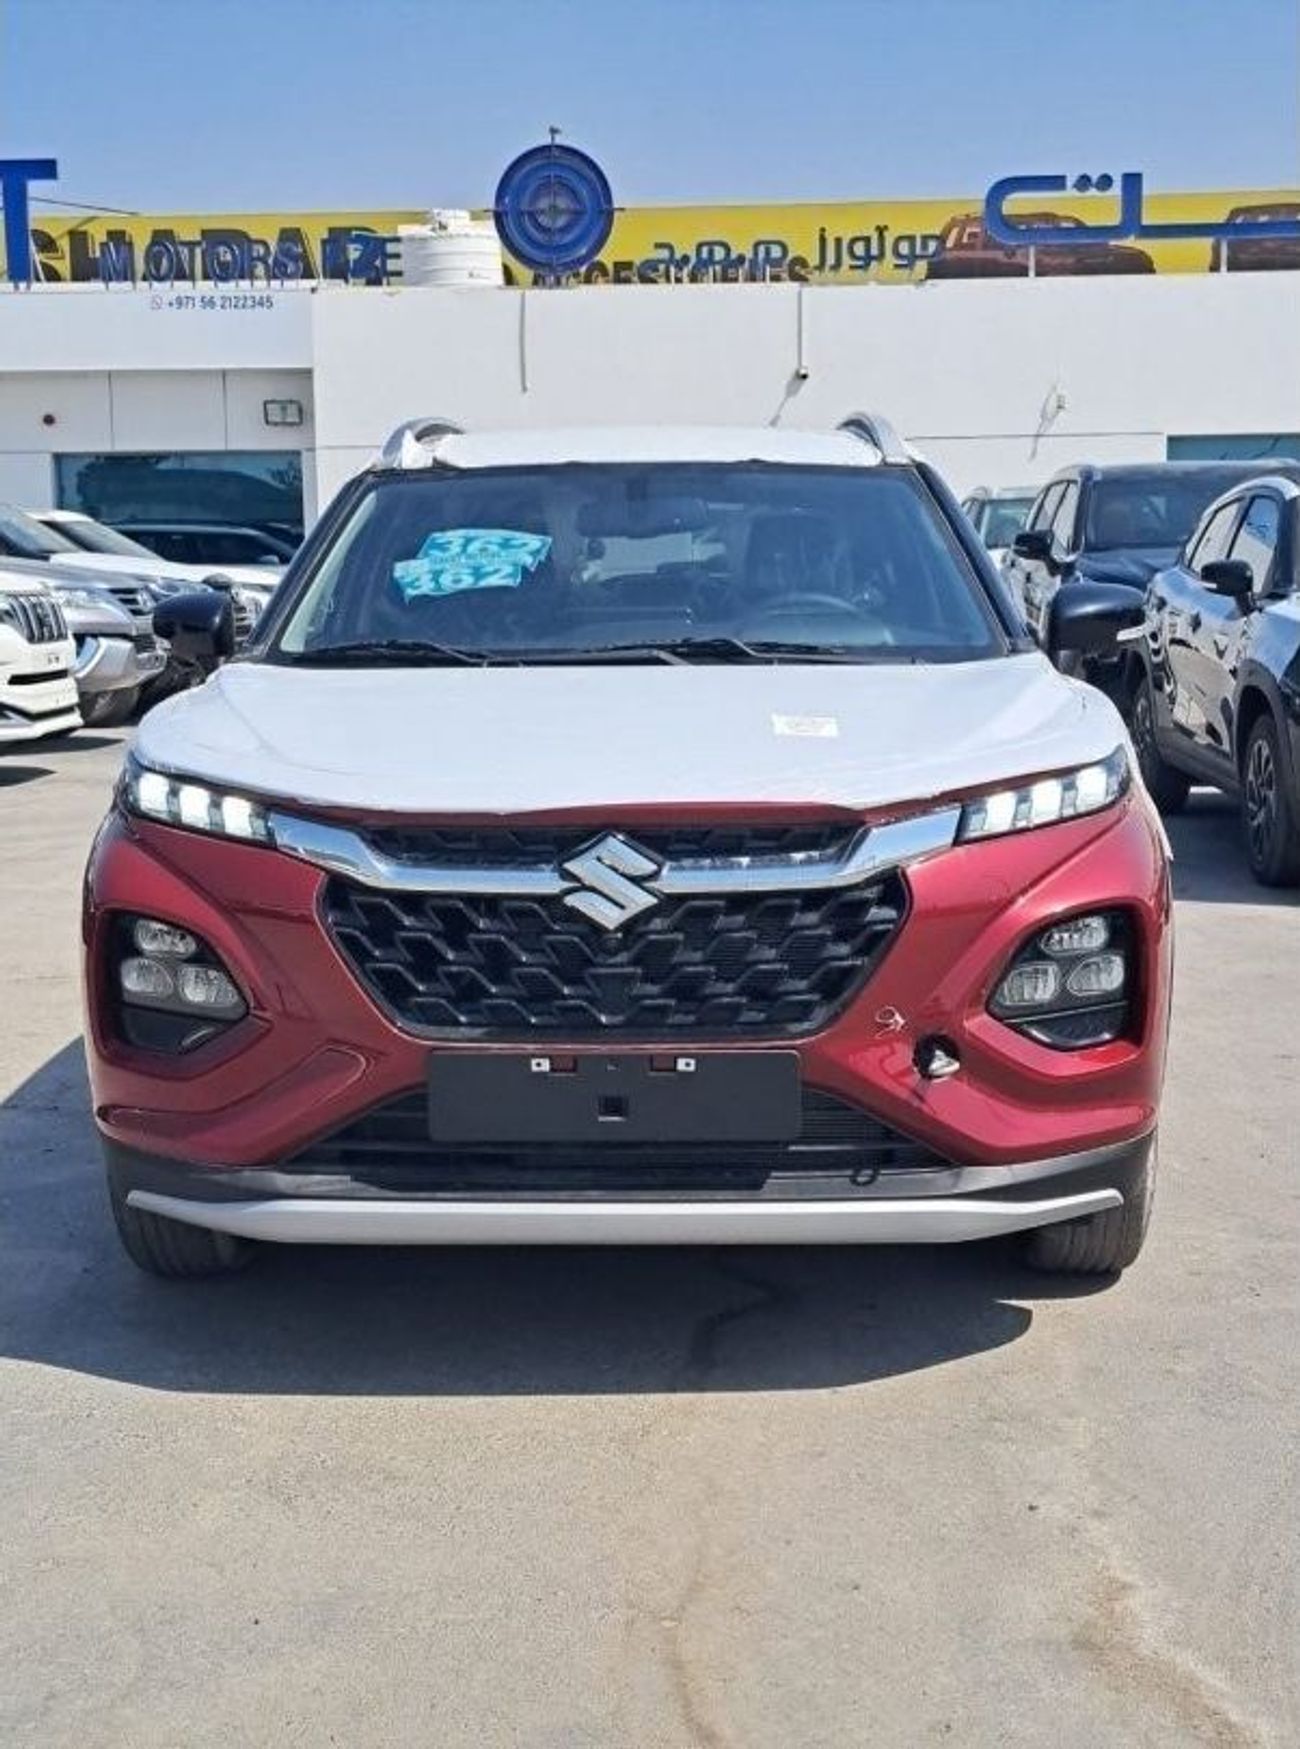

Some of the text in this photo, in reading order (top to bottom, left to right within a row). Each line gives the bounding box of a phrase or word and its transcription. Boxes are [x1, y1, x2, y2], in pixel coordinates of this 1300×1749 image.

[100, 239, 304, 283] MOTORS
[168, 295, 196, 311] +971
[200, 295, 217, 311] 56
